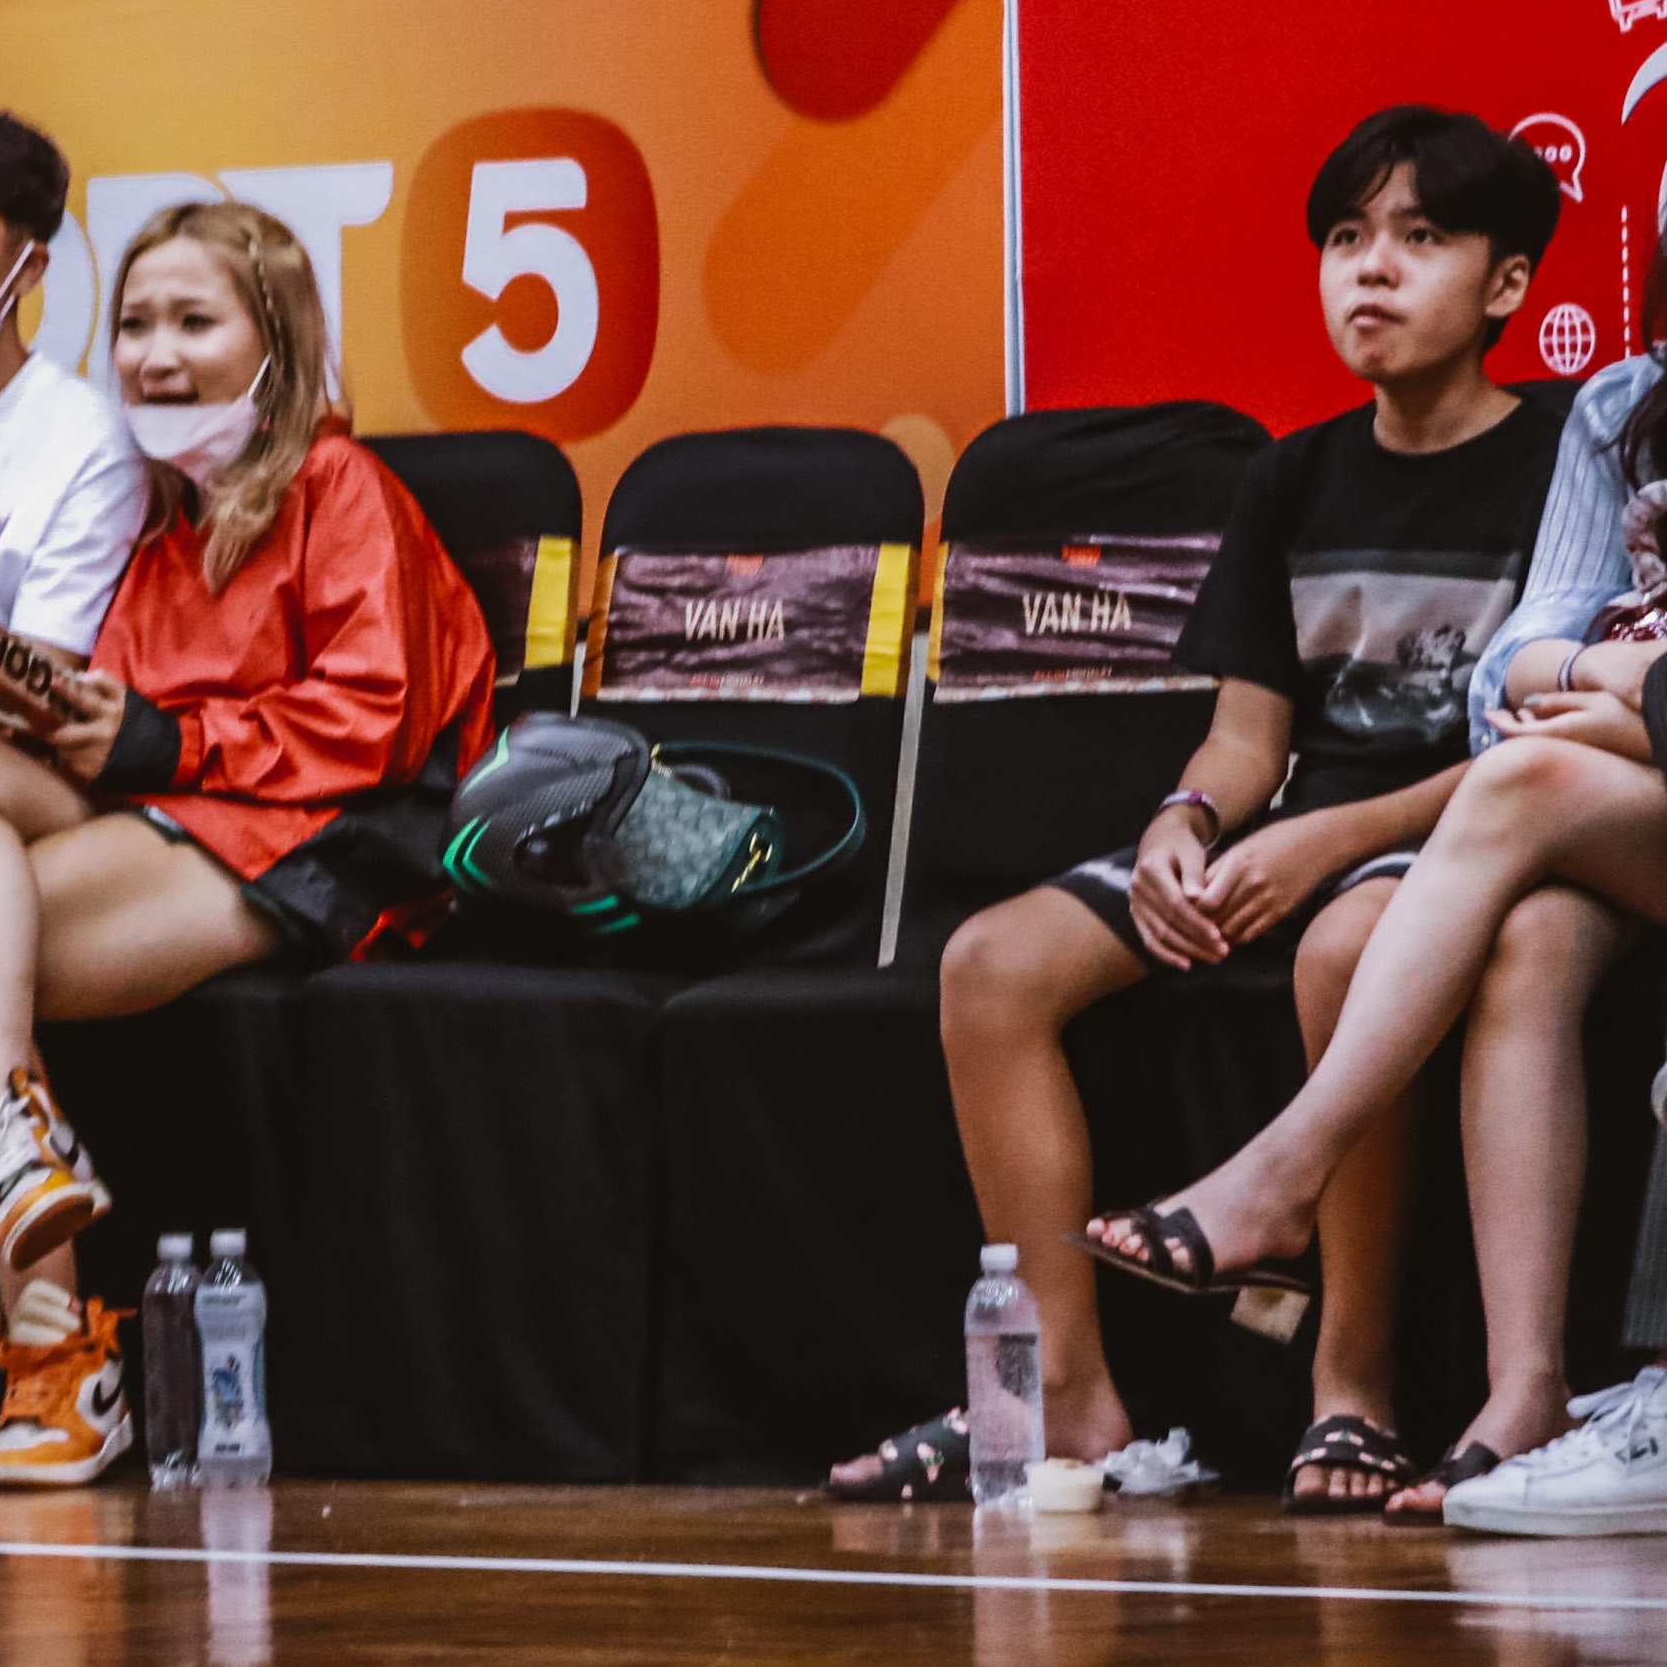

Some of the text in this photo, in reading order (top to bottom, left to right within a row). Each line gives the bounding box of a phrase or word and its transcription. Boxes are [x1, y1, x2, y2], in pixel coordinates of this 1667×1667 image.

[463, 158, 602, 404] 5
[685, 598, 785, 641] VAN HA
[1022, 589, 1132, 635] VAN HA
